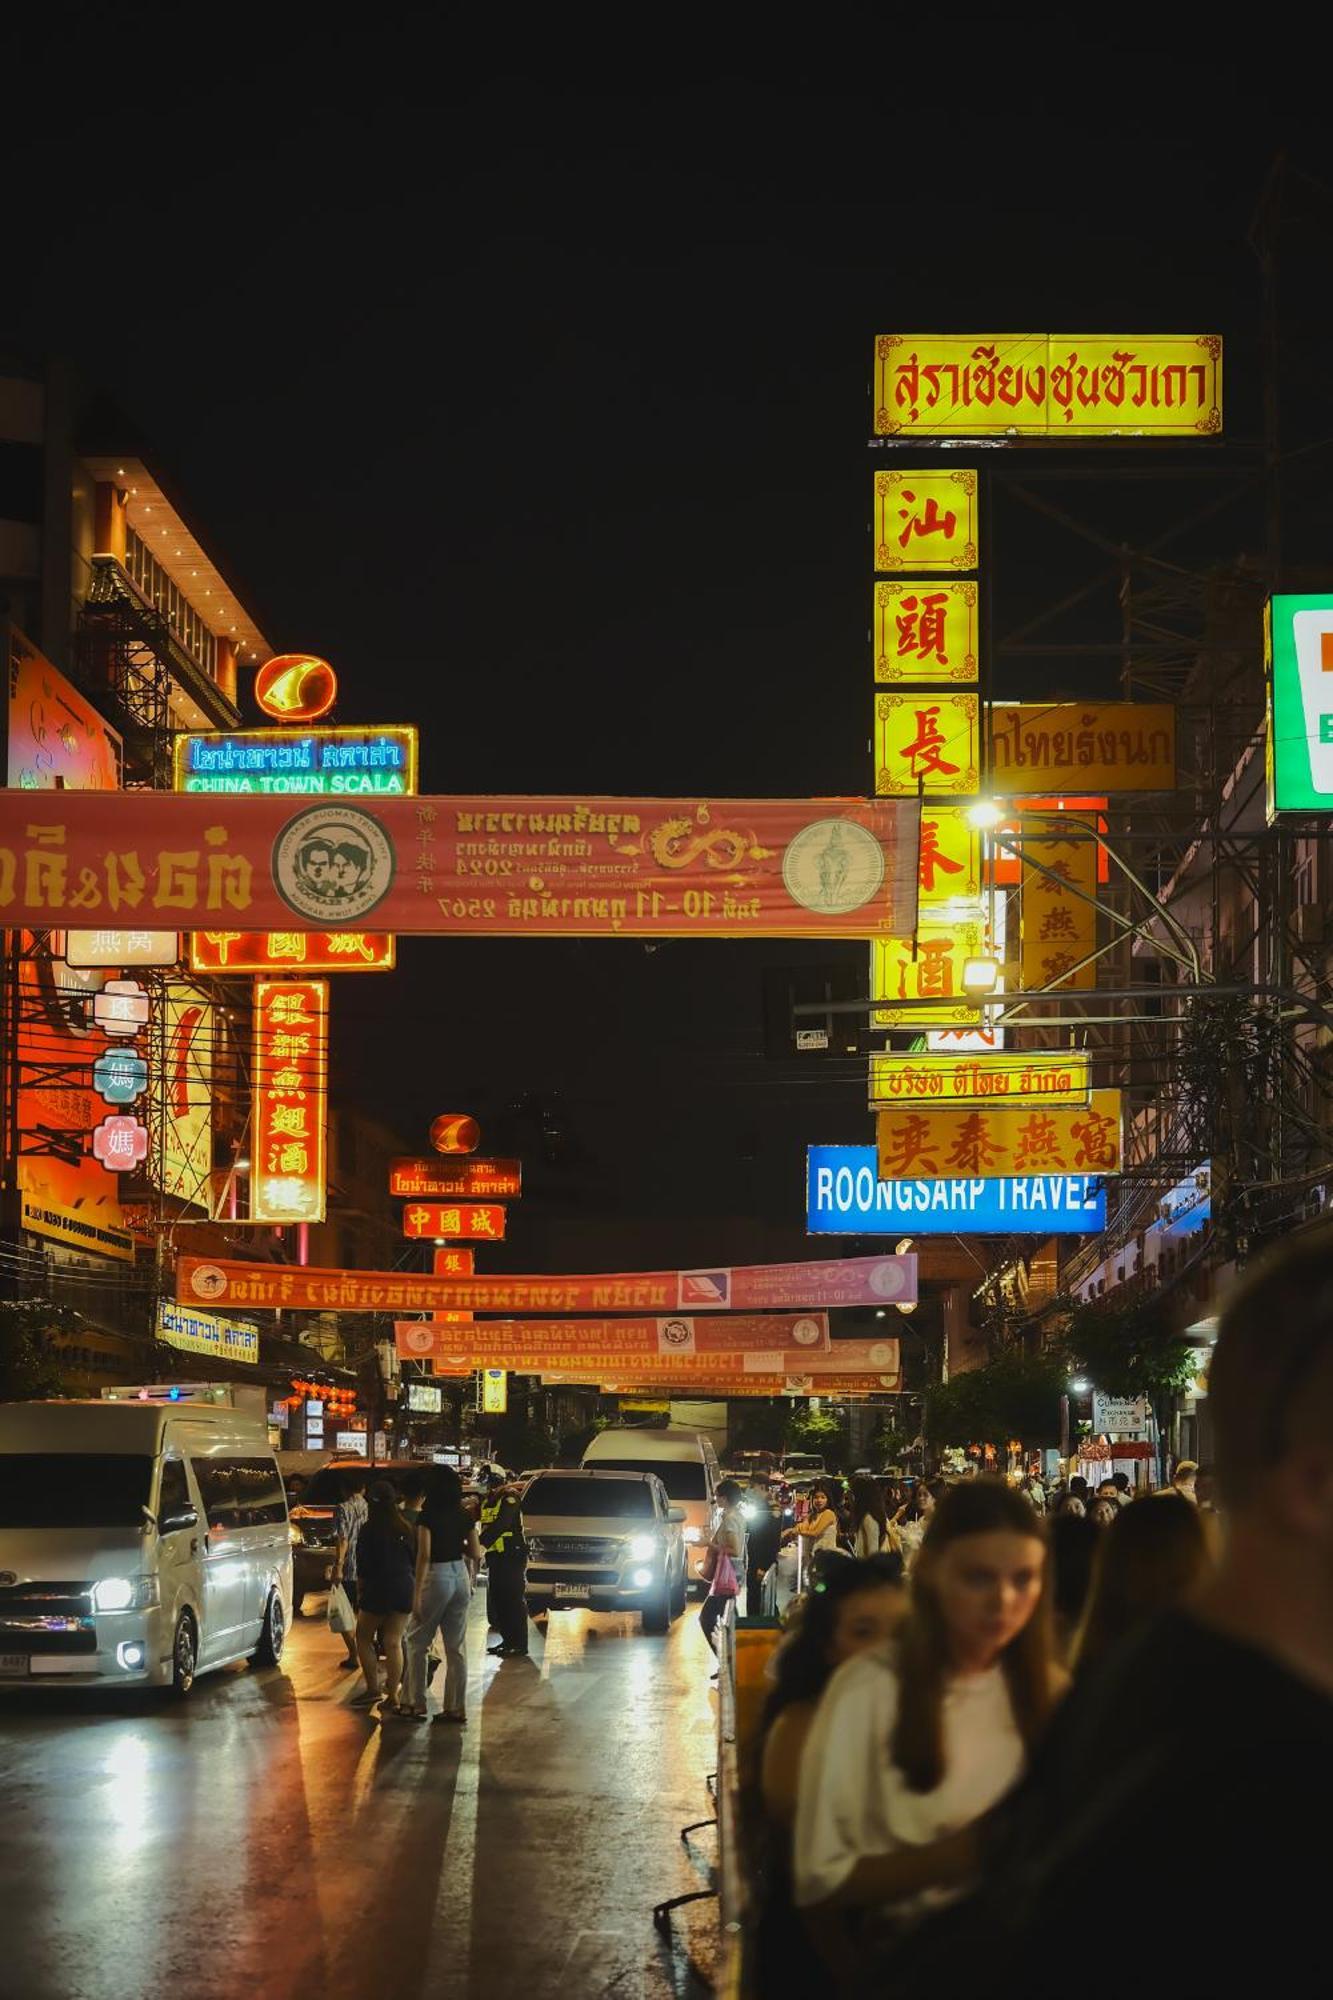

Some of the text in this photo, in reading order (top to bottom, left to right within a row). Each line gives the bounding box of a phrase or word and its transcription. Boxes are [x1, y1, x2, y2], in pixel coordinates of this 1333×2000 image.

[188, 774, 402, 793] CHINA TOWN SCALA
[816, 1166, 1098, 1212] ROONGSARP TRAVEL
[408, 1207, 496, 1236] 中國城
